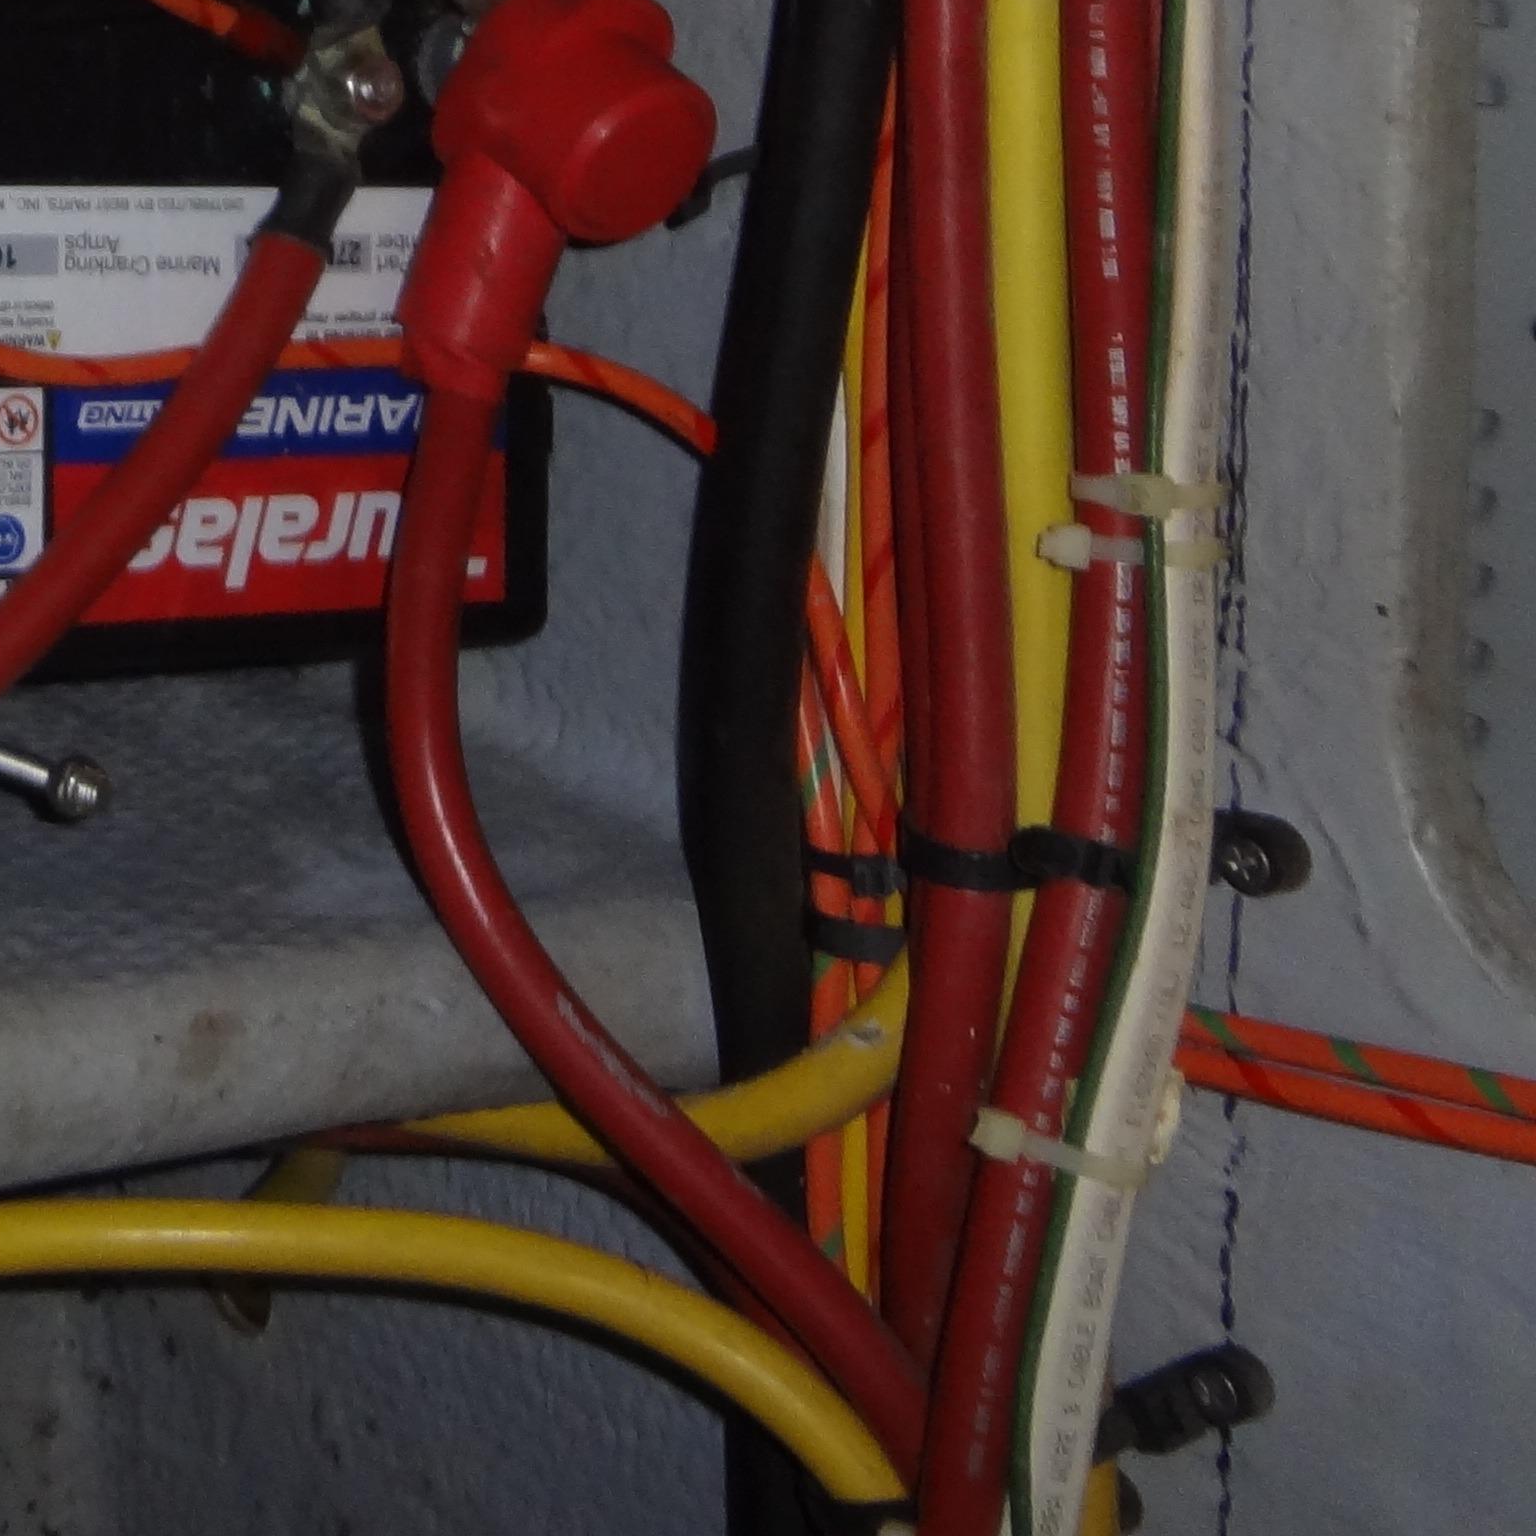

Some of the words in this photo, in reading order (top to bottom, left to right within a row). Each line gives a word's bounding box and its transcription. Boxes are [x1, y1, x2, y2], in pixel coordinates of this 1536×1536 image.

[63, 231, 119, 252] Amps
[63, 251, 150, 276] Cranking
[156, 254, 221, 275] Marine
[235, 390, 424, 440] ARINE
[126, 485, 487, 597] urala
